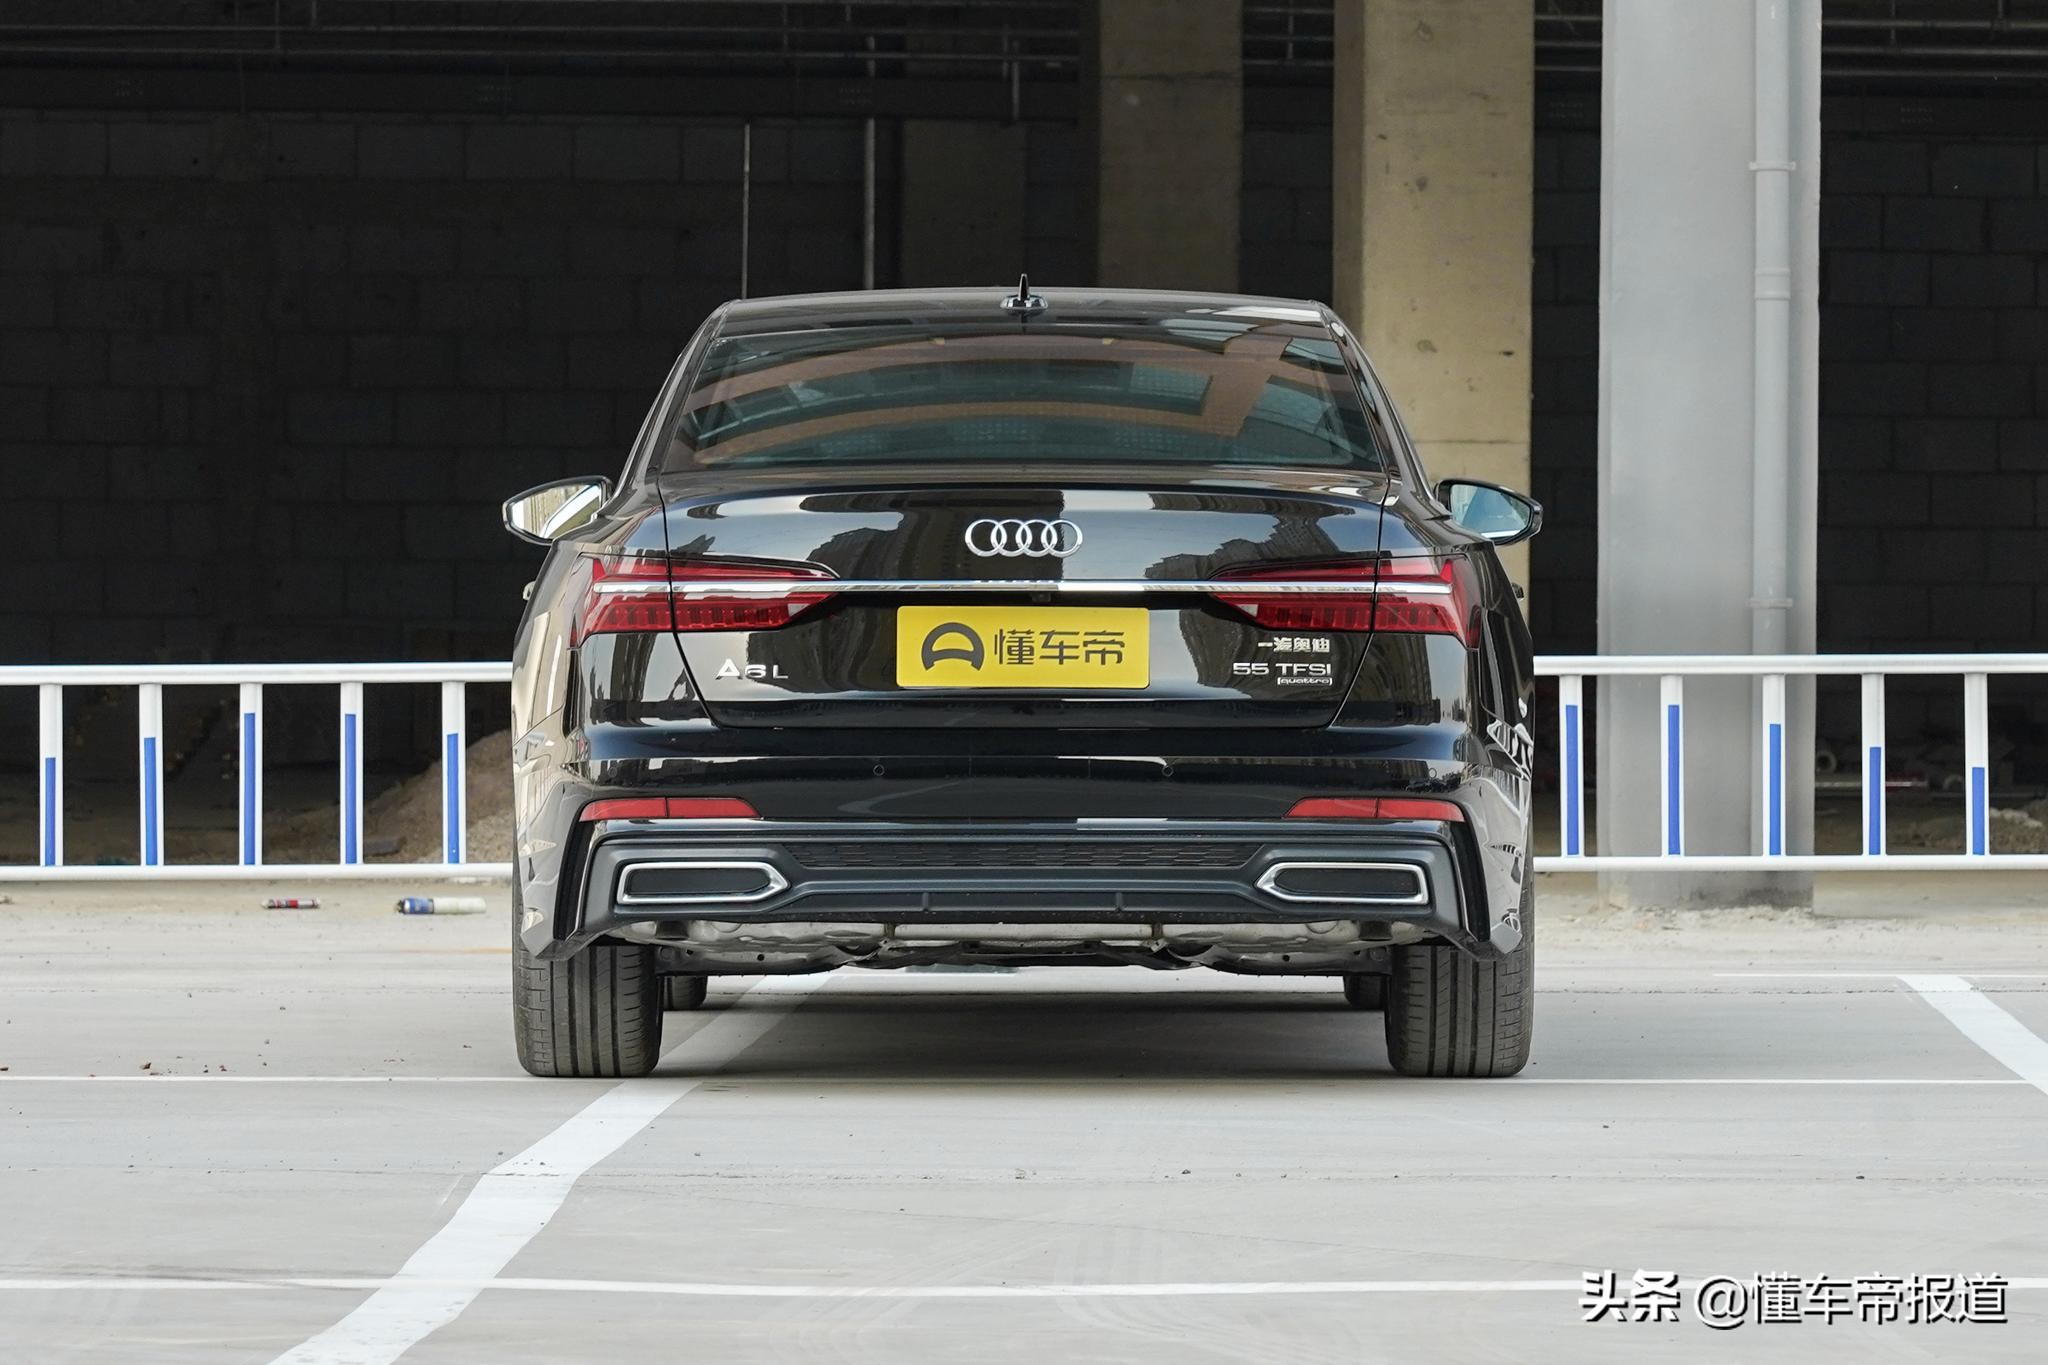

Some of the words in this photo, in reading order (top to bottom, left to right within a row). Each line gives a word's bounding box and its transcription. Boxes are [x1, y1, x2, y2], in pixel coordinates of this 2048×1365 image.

[994, 628, 1125, 665] 懂车帝
[1257, 637, 1330, 653] 一汽奥迪
[1233, 662, 1270, 675] 55
[1275, 662, 1332, 675] TFSI
